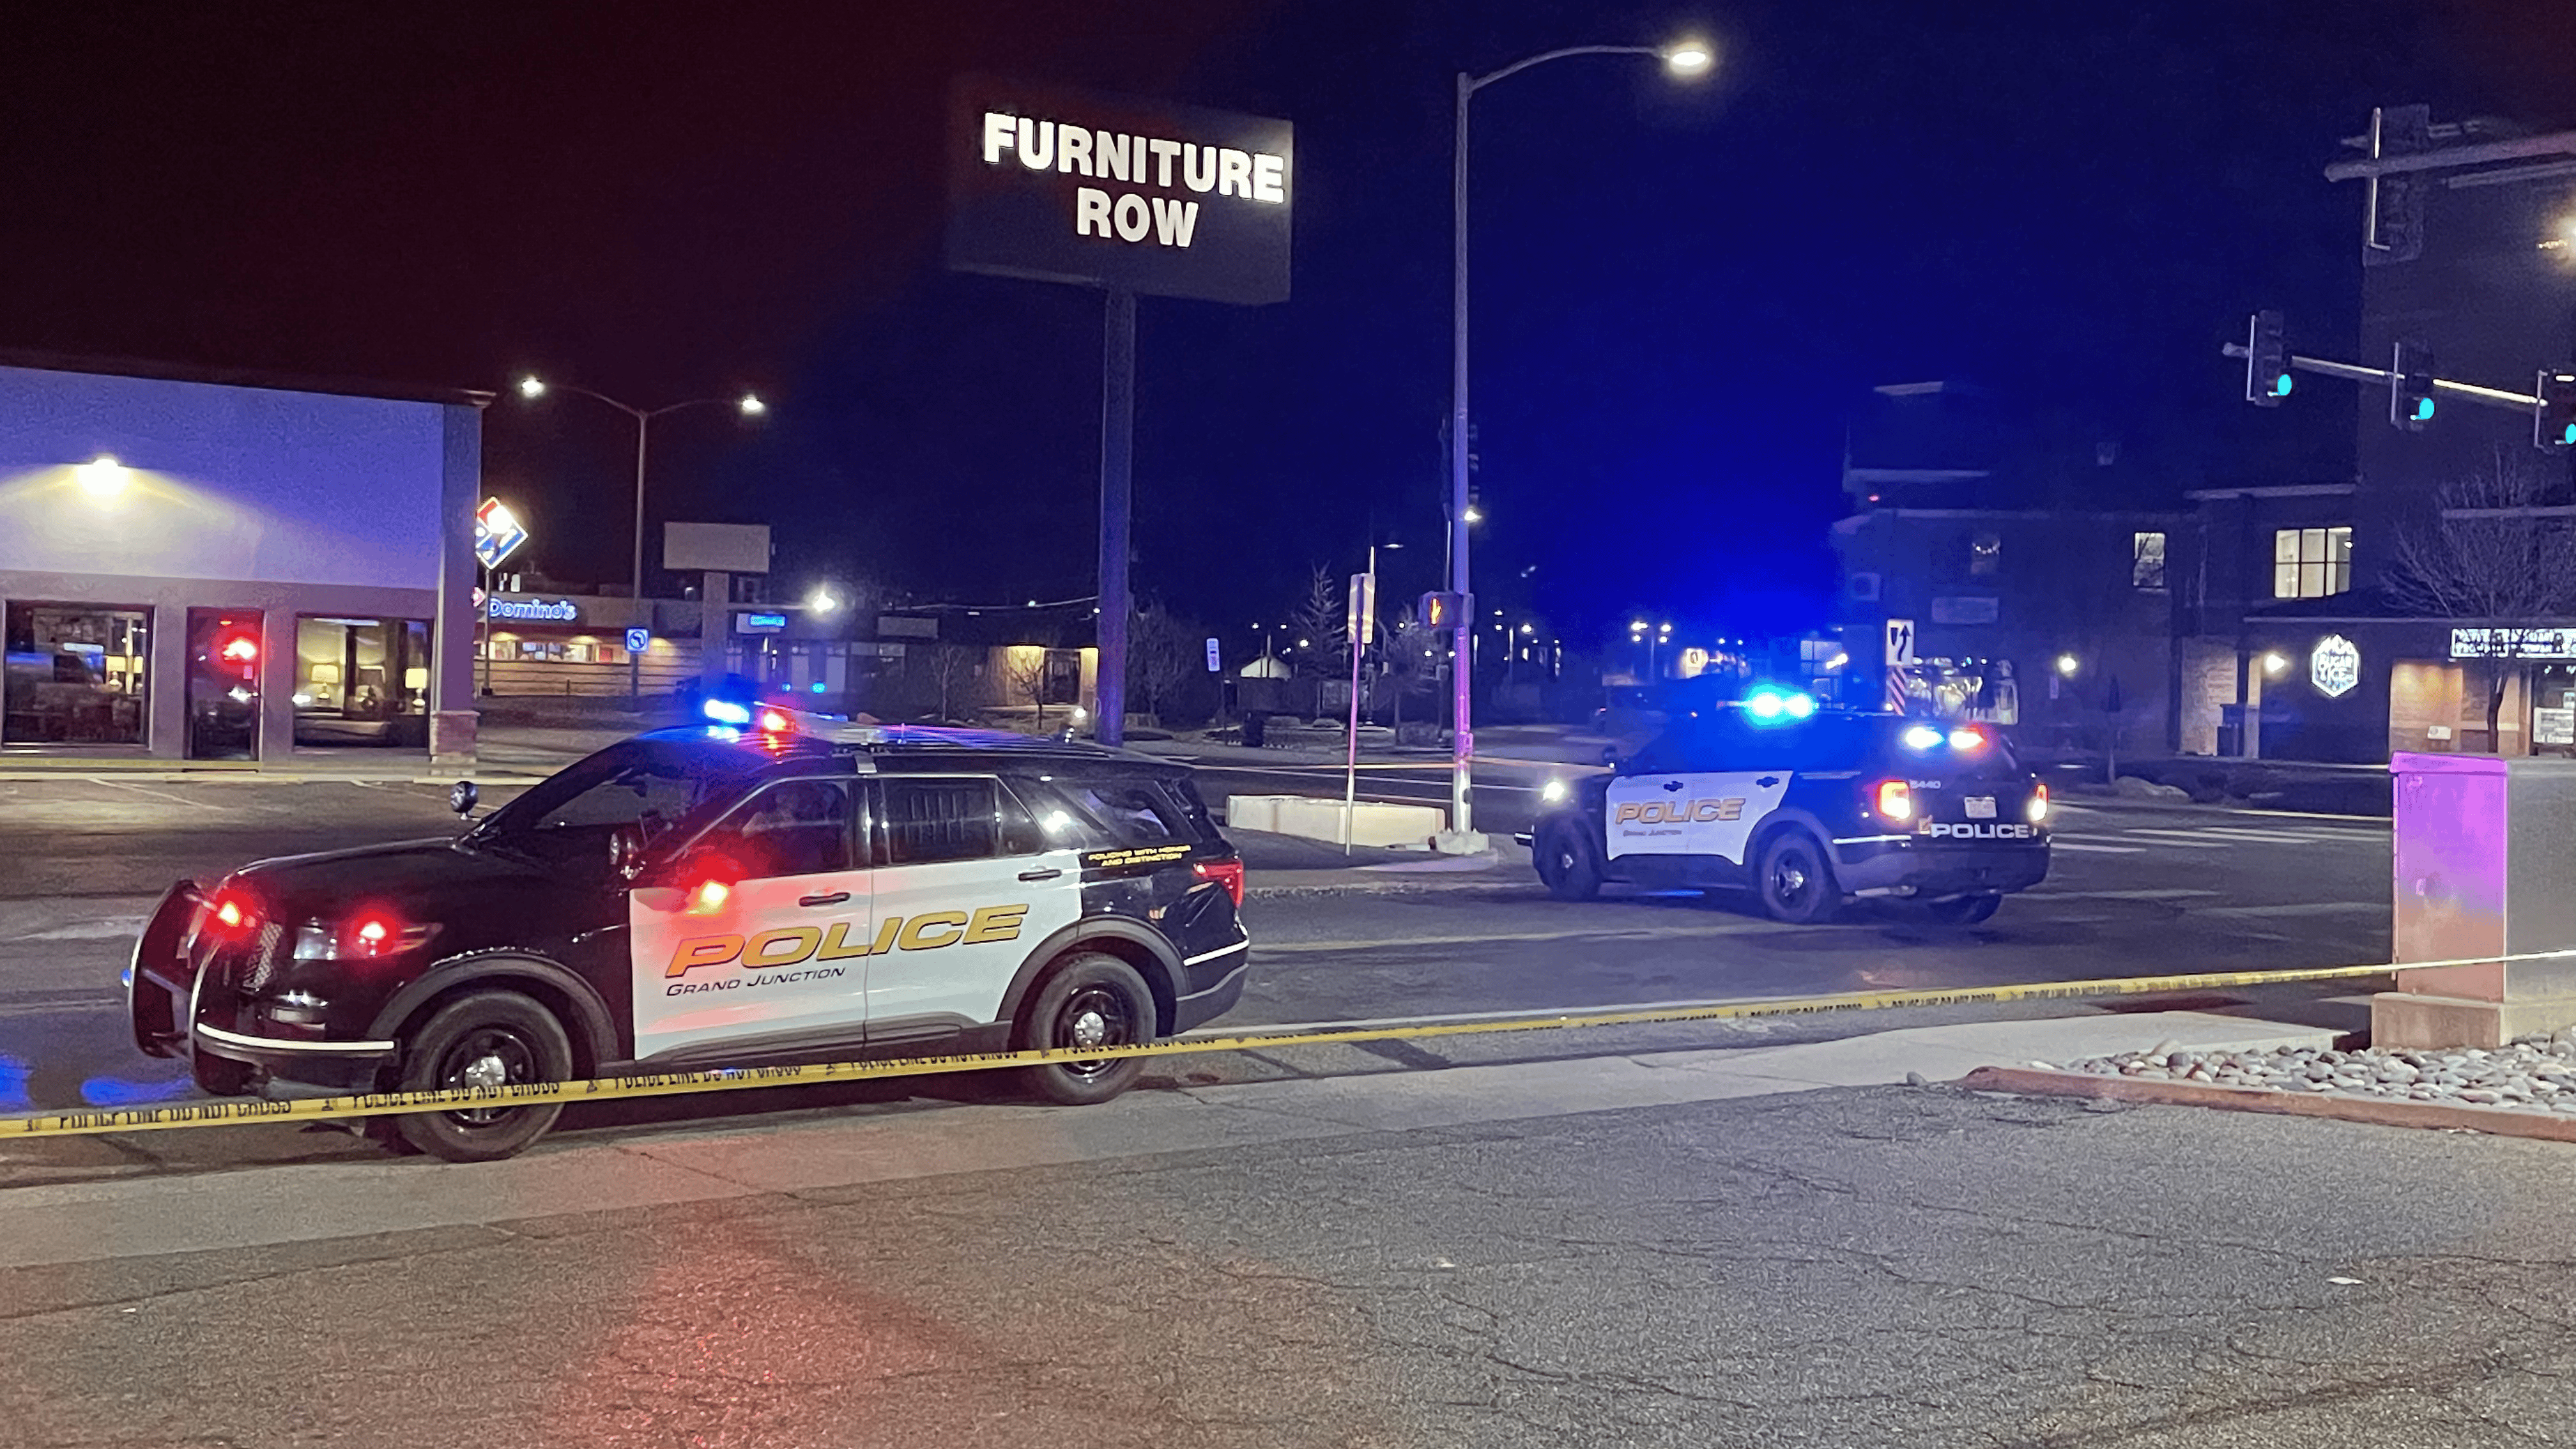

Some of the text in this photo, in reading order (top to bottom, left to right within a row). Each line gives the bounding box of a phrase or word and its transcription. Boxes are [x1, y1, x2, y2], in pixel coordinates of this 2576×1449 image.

[984, 112, 1284, 203] FURNITURE
[1077, 187, 1199, 248] ROW
[489, 597, 577, 620] Domino's
[1615, 798, 1746, 825] POLICE
[1931, 823, 2029, 838] POLICE
[665, 904, 1029, 977] POLICE
[666, 967, 846, 996] GRAND JUNCTION
